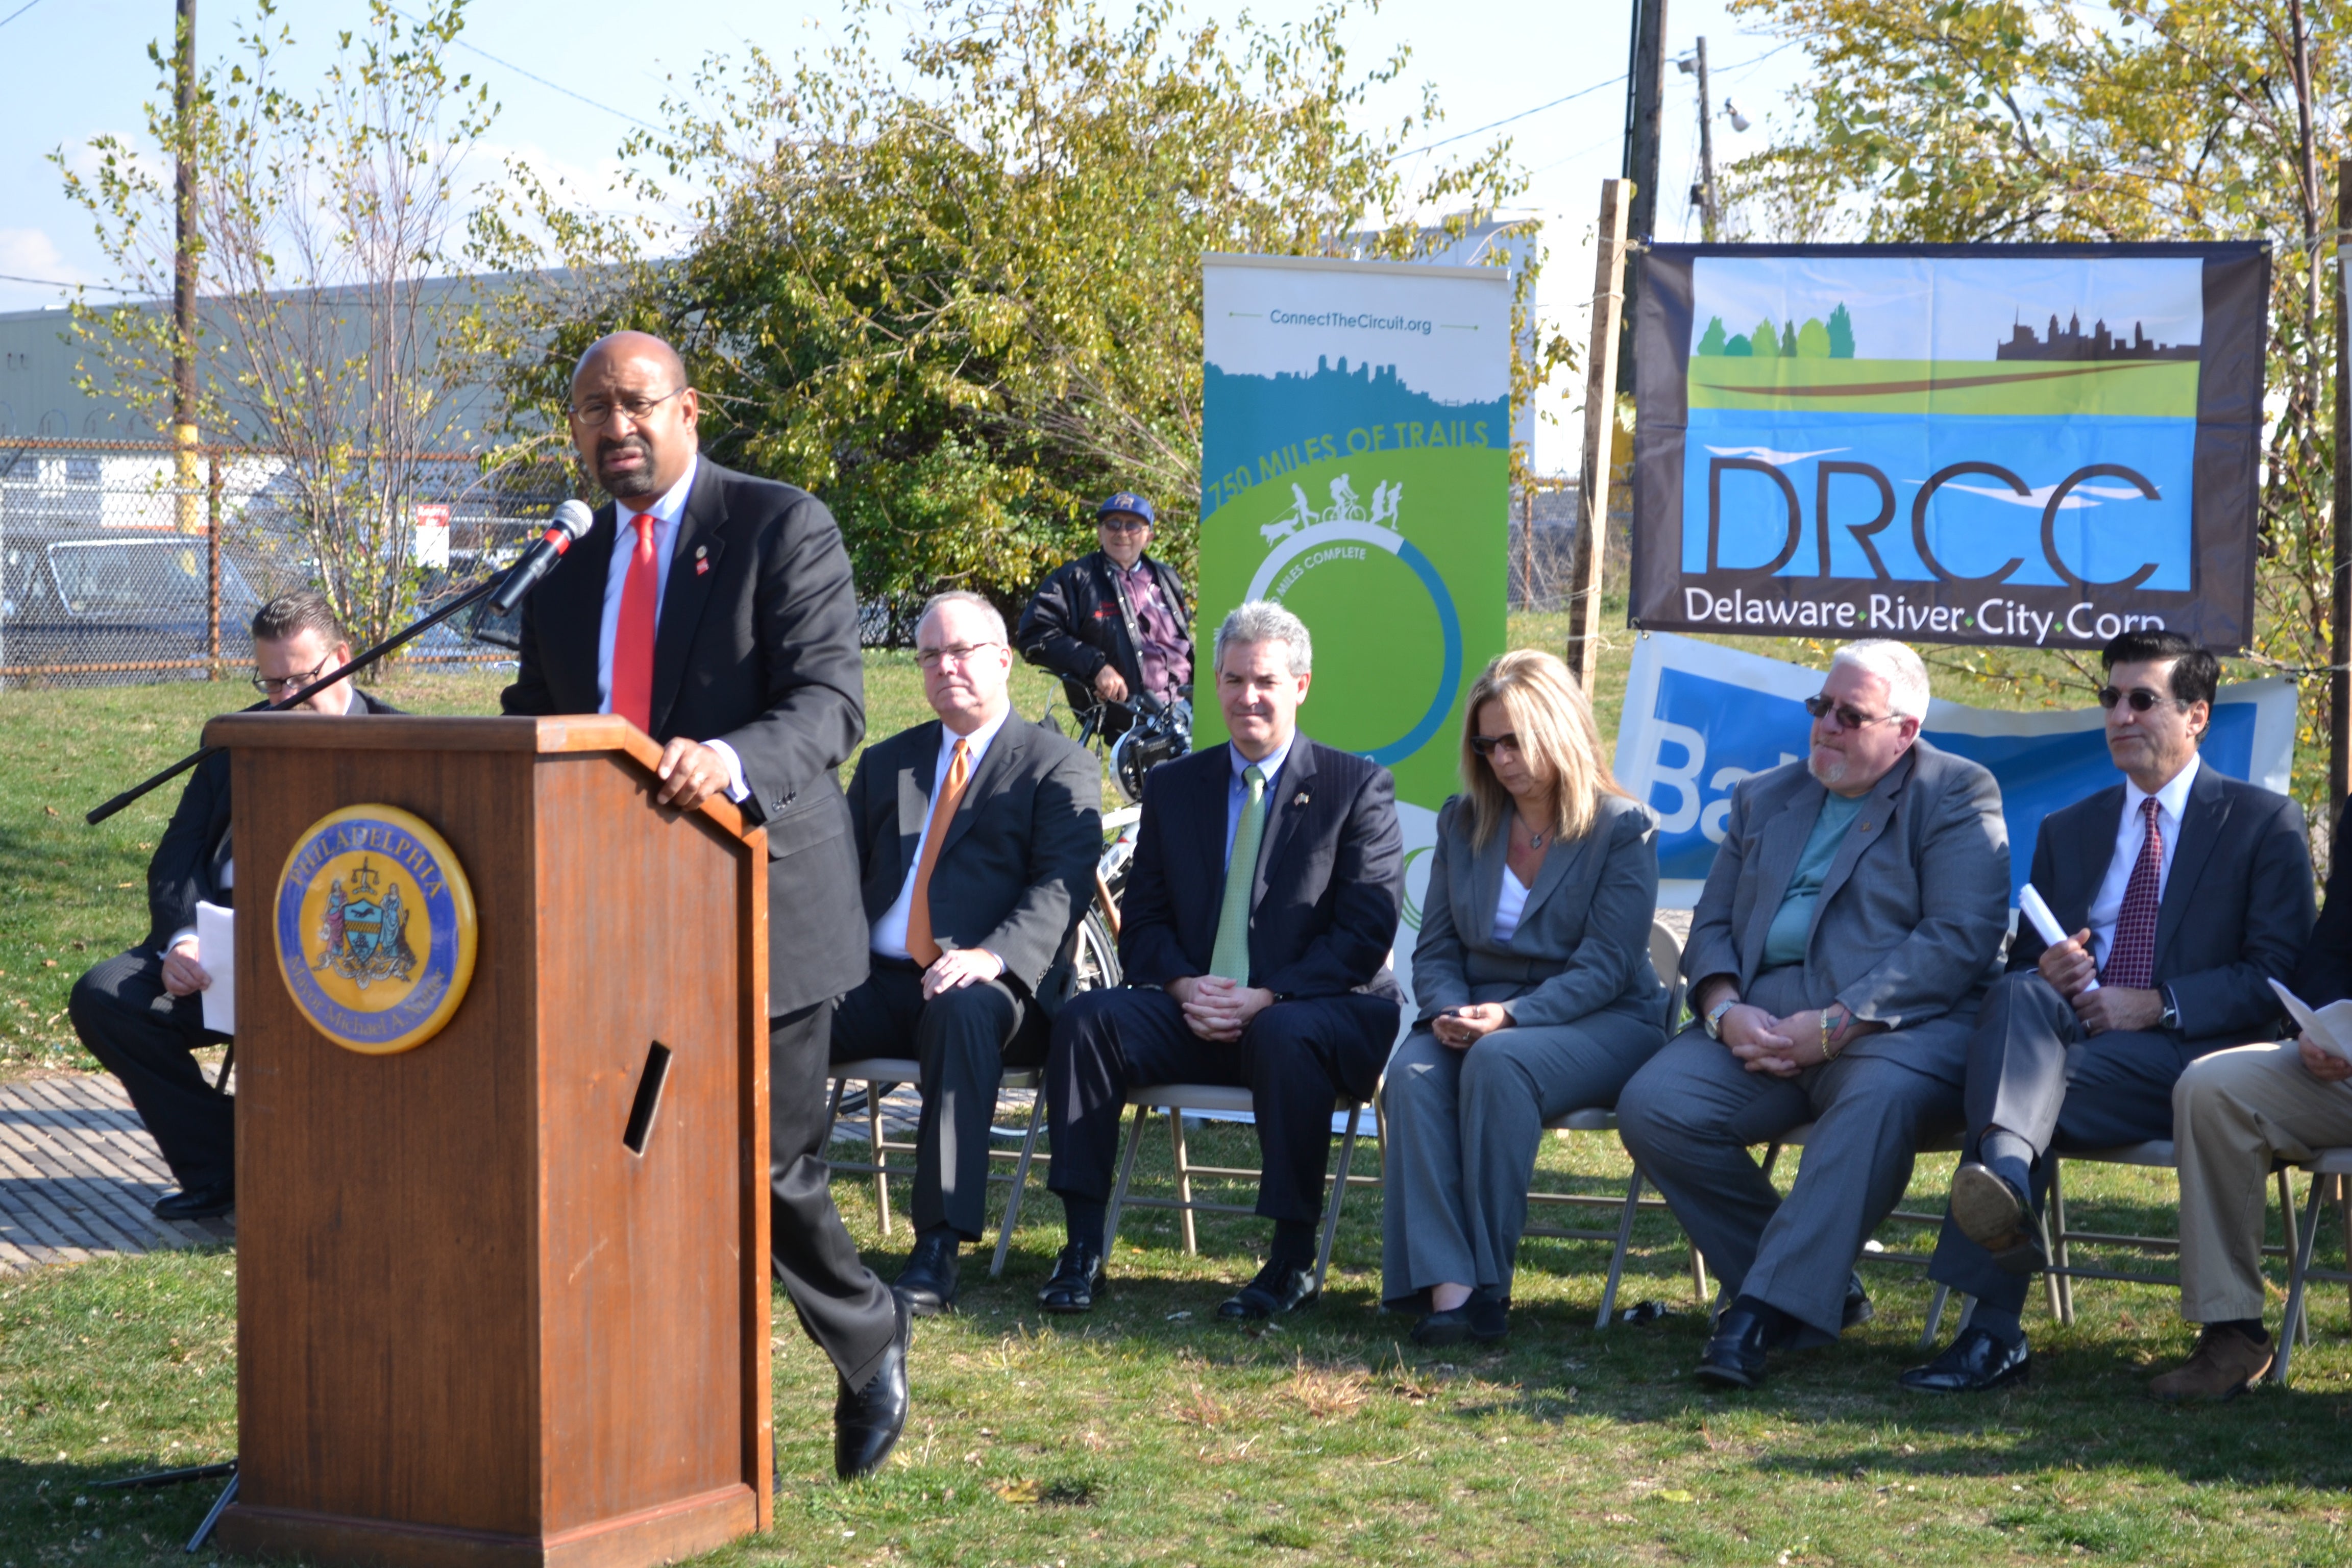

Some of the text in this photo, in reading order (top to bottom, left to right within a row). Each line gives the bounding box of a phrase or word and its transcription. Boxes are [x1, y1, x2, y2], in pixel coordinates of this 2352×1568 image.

[1270, 309, 1432, 334] ConnectTheCircuit.org
[1207, 421, 1489, 508] 750 MILES OF TRAILS
[1706, 457, 2162, 586] DRCC
[1276, 546, 1366, 597] MILES COMPLETE
[1685, 587, 1854, 627] Delaware
[1870, 594, 1965, 632] River
[1977, 598, 2054, 645] City
[289, 826, 443, 899] PHILADELPHIA
[287, 954, 446, 1037] Mayor Michael A. Nutter
